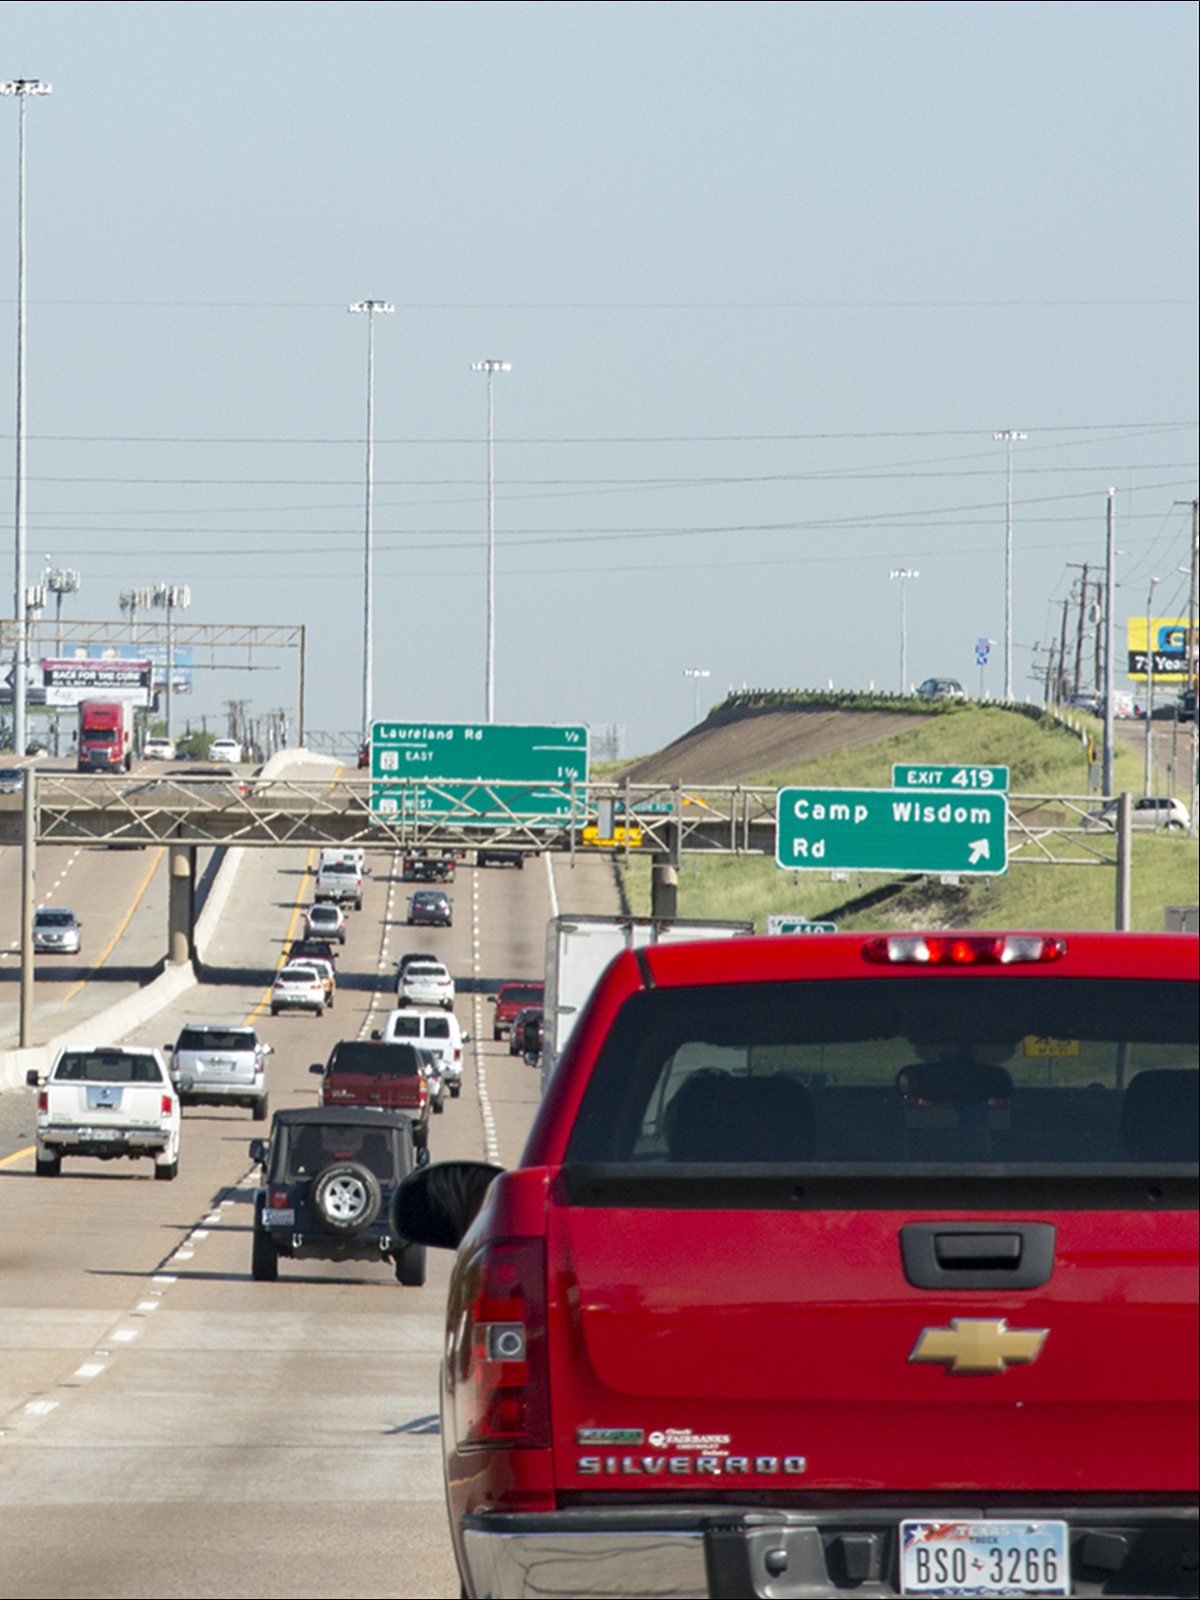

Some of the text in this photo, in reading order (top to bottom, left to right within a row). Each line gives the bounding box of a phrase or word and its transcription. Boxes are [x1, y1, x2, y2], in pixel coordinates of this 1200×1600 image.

[52, 670, 76, 680] RACE
[78, 670, 97, 680] FOR
[379, 726, 454, 741] Laureland
[464, 729, 484, 741] Rd
[405, 751, 434, 762] EAST
[383, 758, 396, 769] 12
[906, 768, 995, 788] EXIT 419
[404, 799, 433, 810] WST
[793, 799, 991, 825] Camp Wisdom
[793, 837, 826, 860] Rd
[666, 1435, 731, 1444] FAIRBANKS
[577, 1455, 808, 1475] SILVERADO
[955, 1525, 1012, 1537] TEXAS
[969, 1536, 999, 1545] TRUCK
[989, 1547, 1057, 1584] 3266
